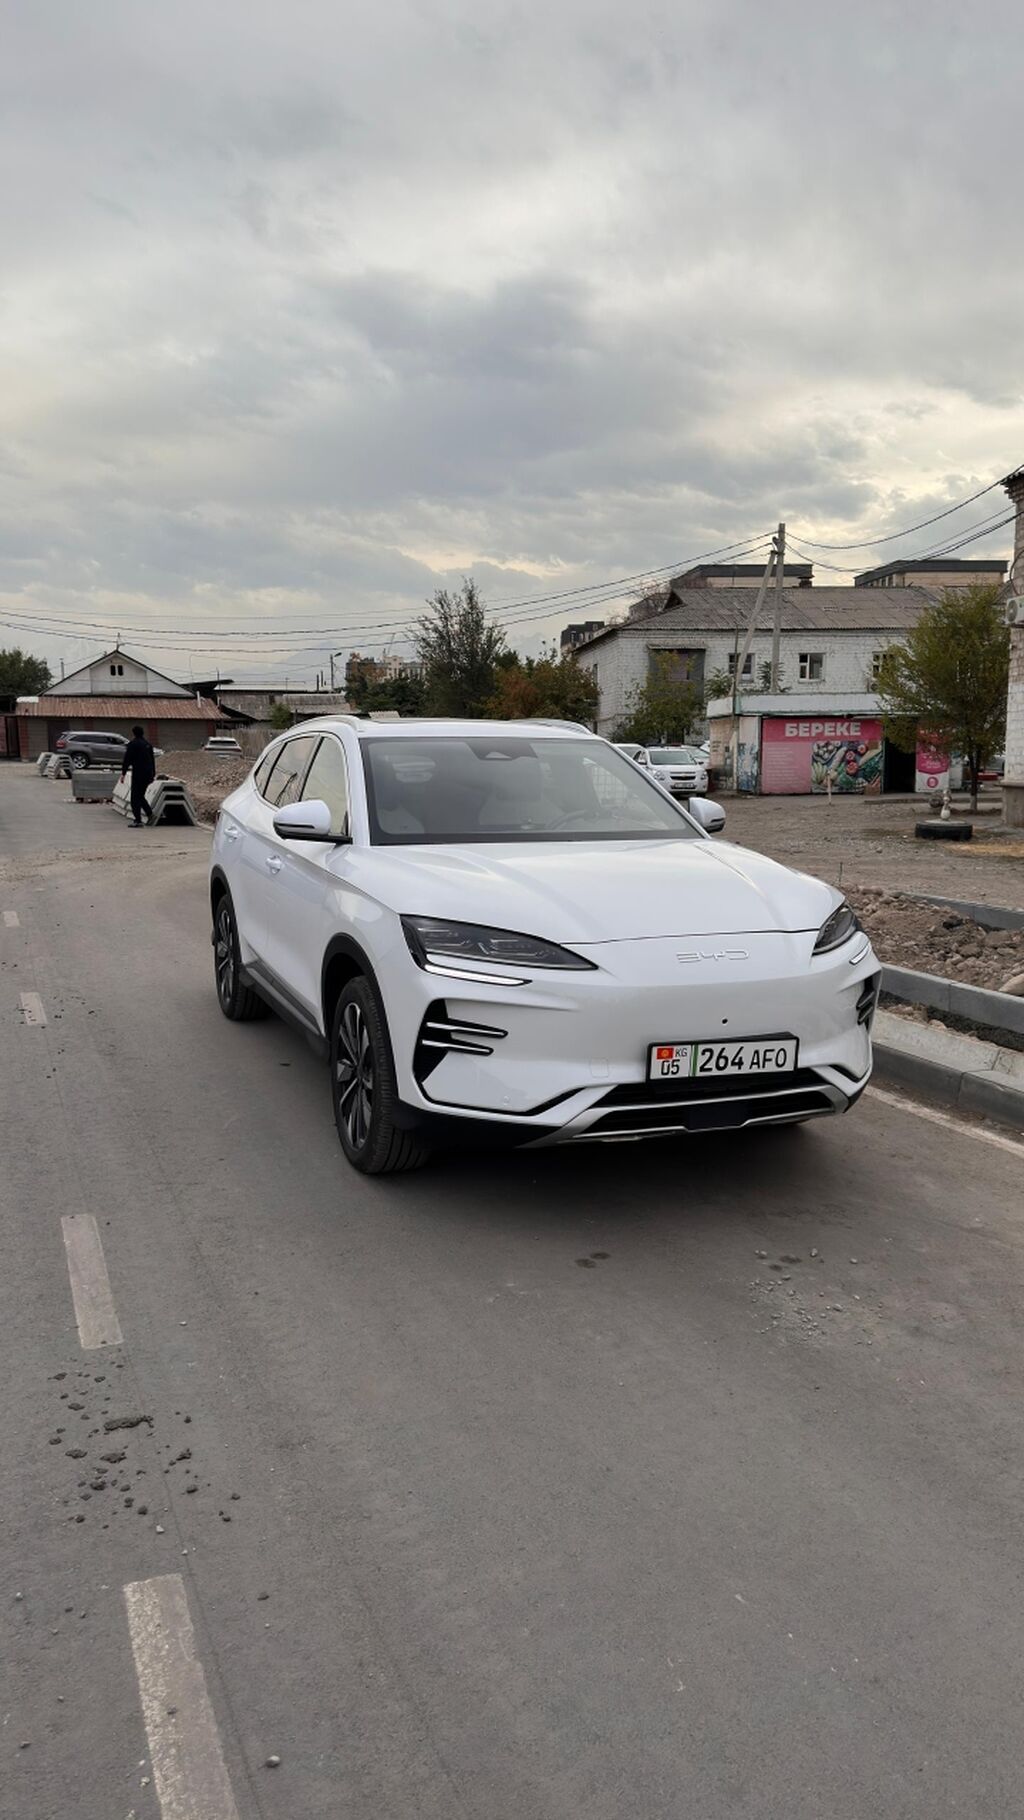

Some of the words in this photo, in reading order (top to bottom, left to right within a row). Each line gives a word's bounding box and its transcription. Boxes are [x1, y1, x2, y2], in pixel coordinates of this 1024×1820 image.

[785, 721, 861, 738] БЕРЕКЕ
[676, 949, 749, 964] BYD
[674, 1047, 688, 1058] KG
[699, 1046, 744, 1073] 264
[660, 1059, 680, 1076] 05
